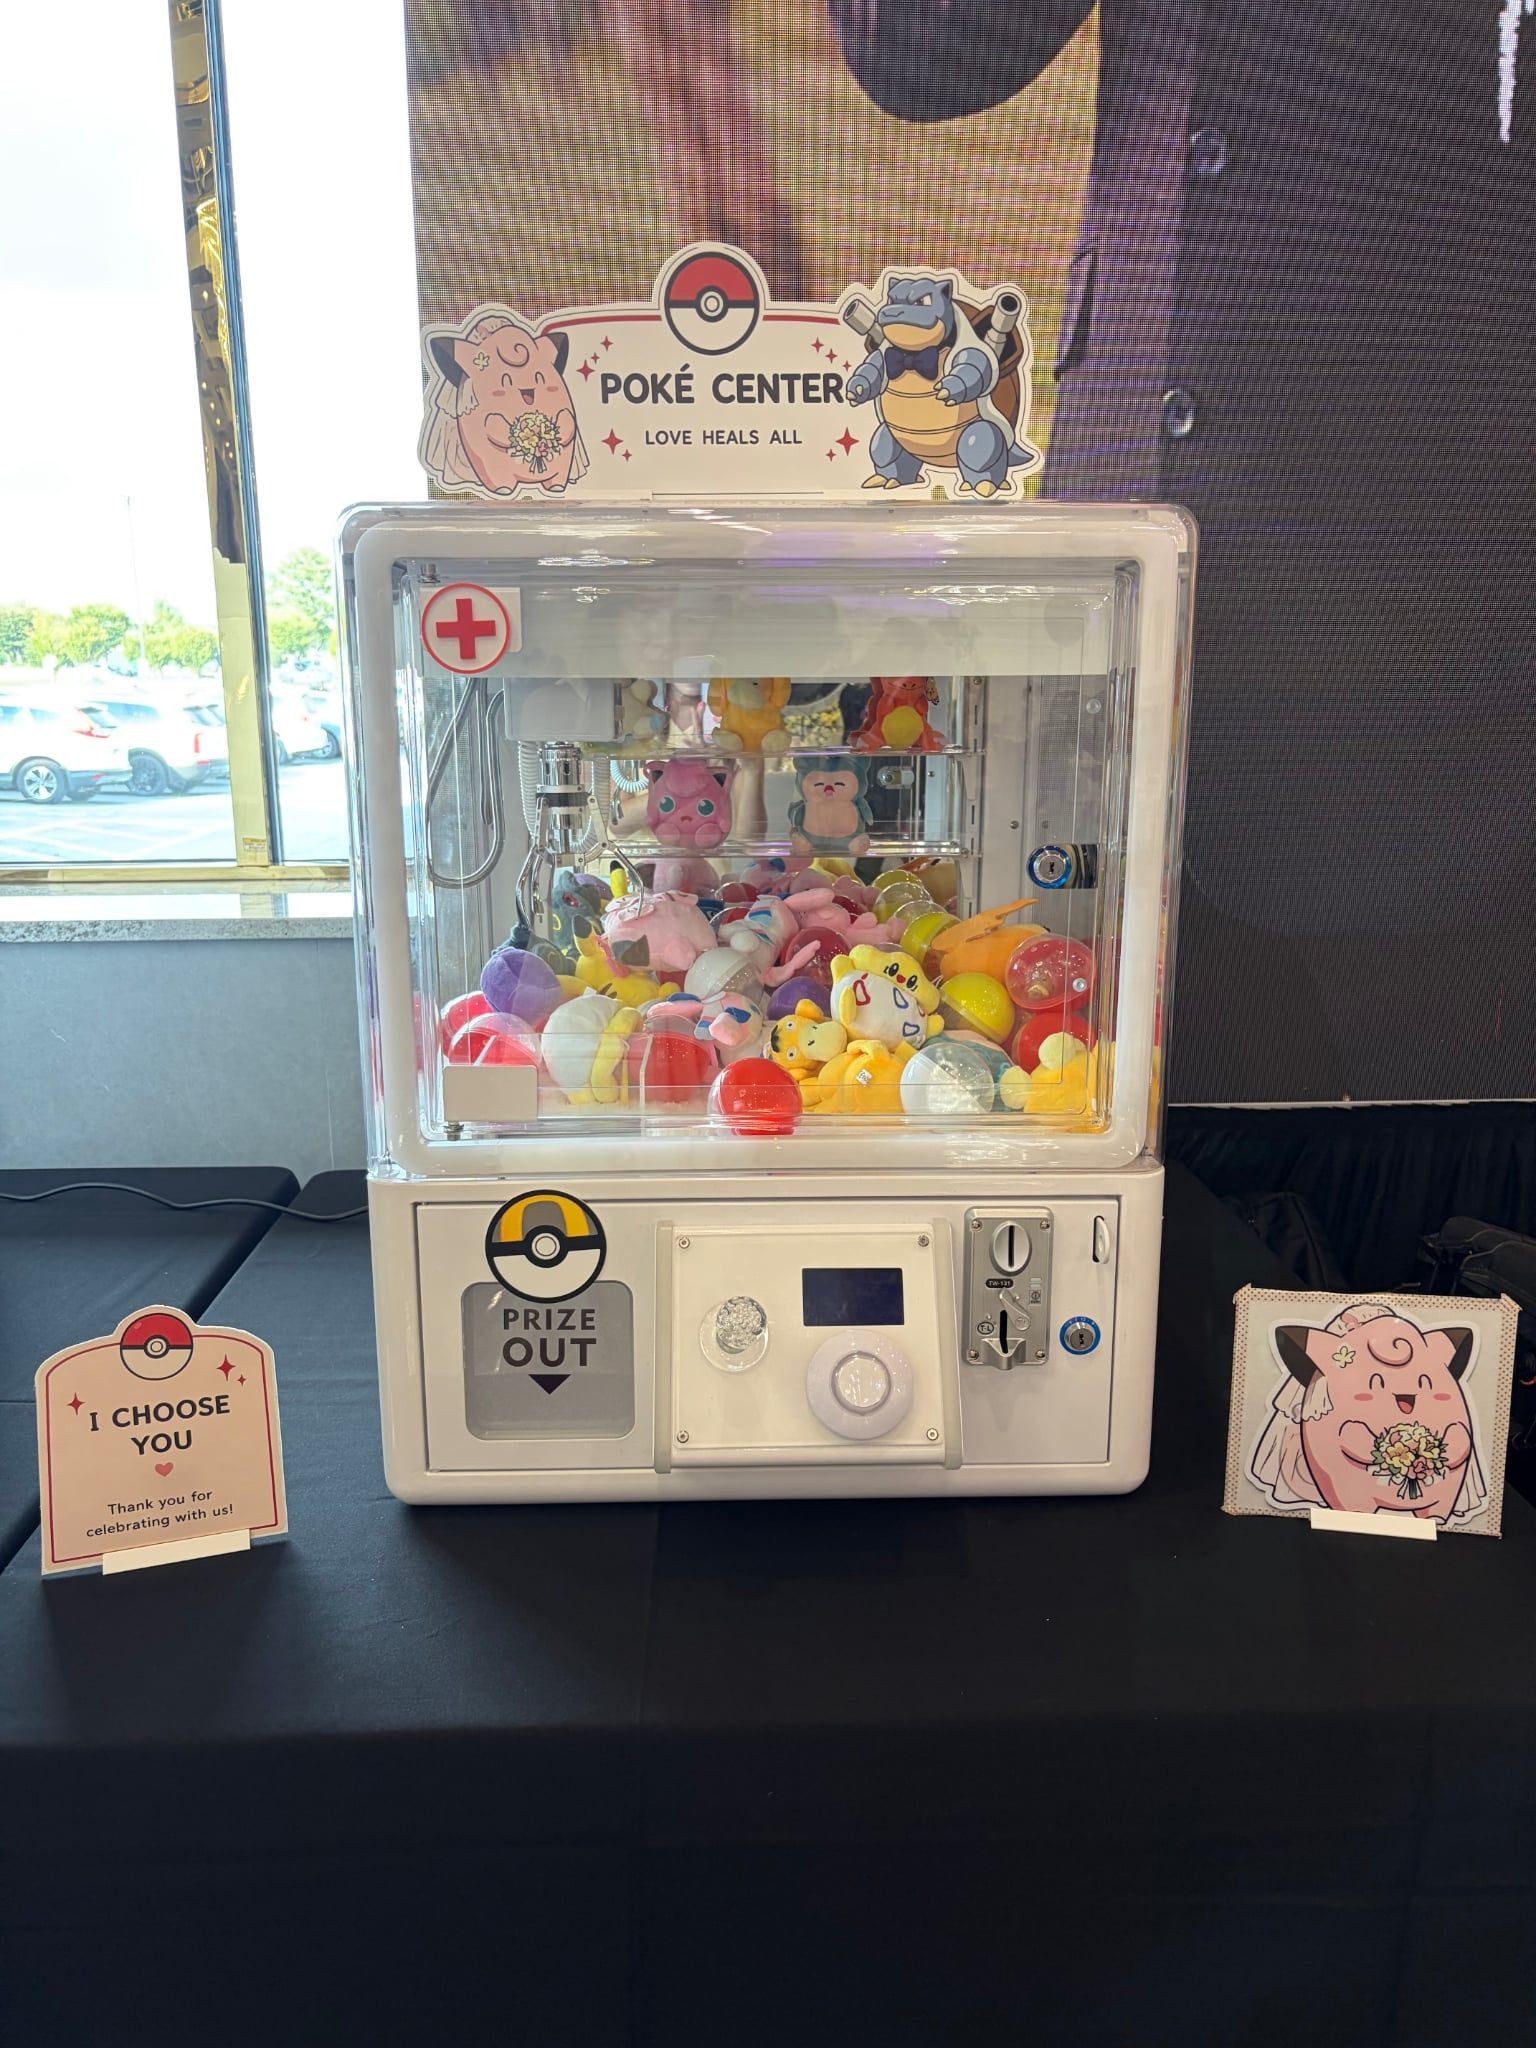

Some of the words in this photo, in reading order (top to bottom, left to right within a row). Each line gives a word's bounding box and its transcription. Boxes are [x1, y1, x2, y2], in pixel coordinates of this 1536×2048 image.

[600, 363, 695, 404] POKÉ
[712, 372, 844, 404] CENTER
[645, 430, 692, 445] LOVE
[703, 429, 760, 445] HEALS
[769, 429, 802, 444] ALL
[503, 1308, 596, 1331] PRIZE
[502, 1337, 597, 1367] OUT
[89, 1412, 100, 1432] I
[111, 1395, 230, 1428] CHOOSE
[130, 1429, 193, 1456] YOU
[107, 1498, 154, 1515] Thank
[158, 1496, 185, 1510] you
[191, 1490, 213, 1502] for
[86, 1516, 170, 1537] celebrating
[174, 1509, 206, 1523] with
[212, 1503, 233, 1516] us!
